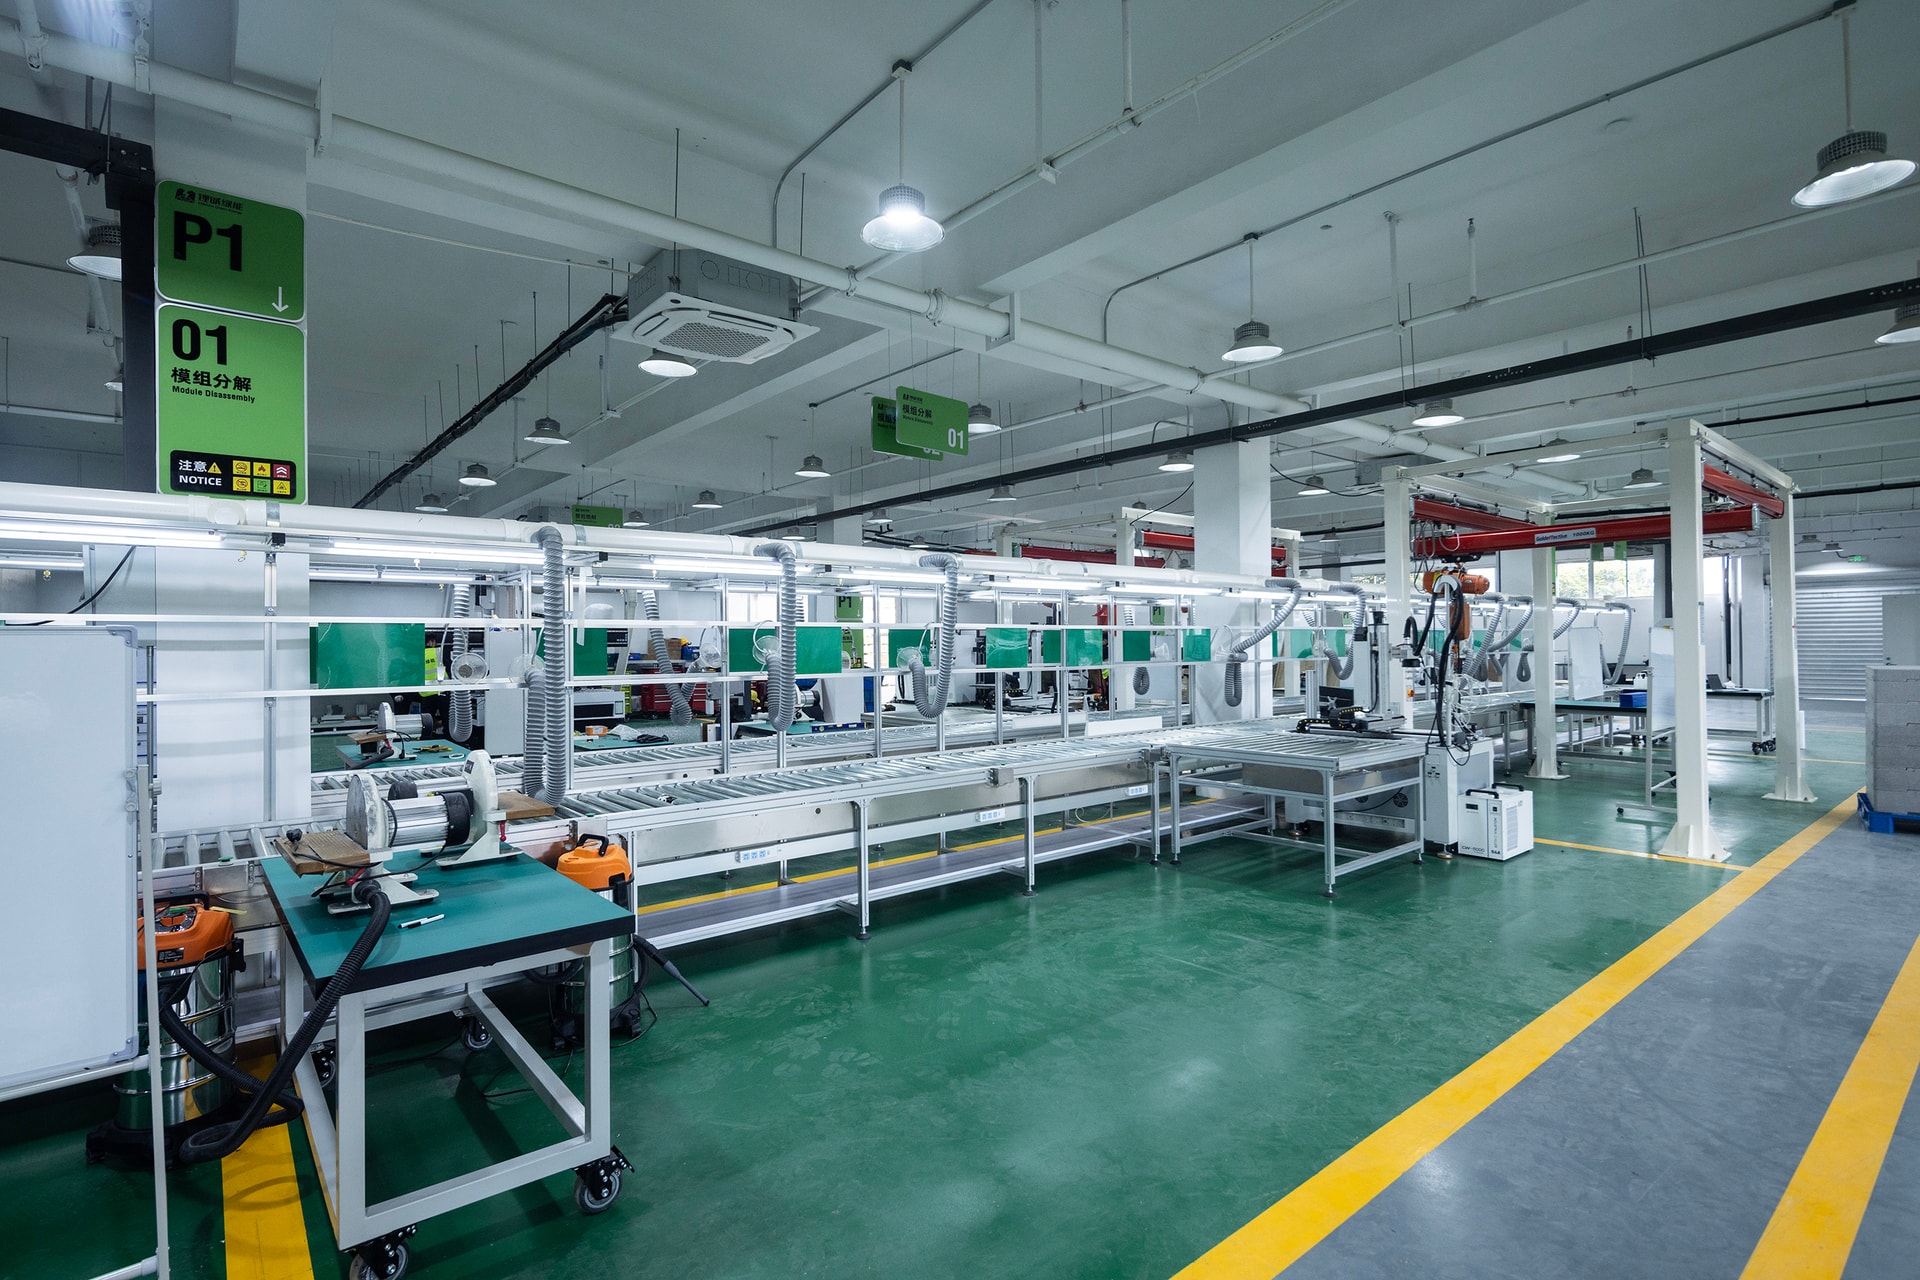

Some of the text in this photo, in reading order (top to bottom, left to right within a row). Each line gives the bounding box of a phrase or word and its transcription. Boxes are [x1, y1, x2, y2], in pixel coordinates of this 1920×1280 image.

[174, 210, 242, 272] P1
[172, 319, 227, 365] 01
[171, 367, 252, 392] 模组分解
[172, 385, 256, 404] Module Disassembly
[902, 404, 933, 419] 模组分解
[948, 428, 964, 449] 01
[178, 459, 208, 473] 注意
[179, 475, 222, 486] NOTICE
[838, 596, 852, 608] P1
